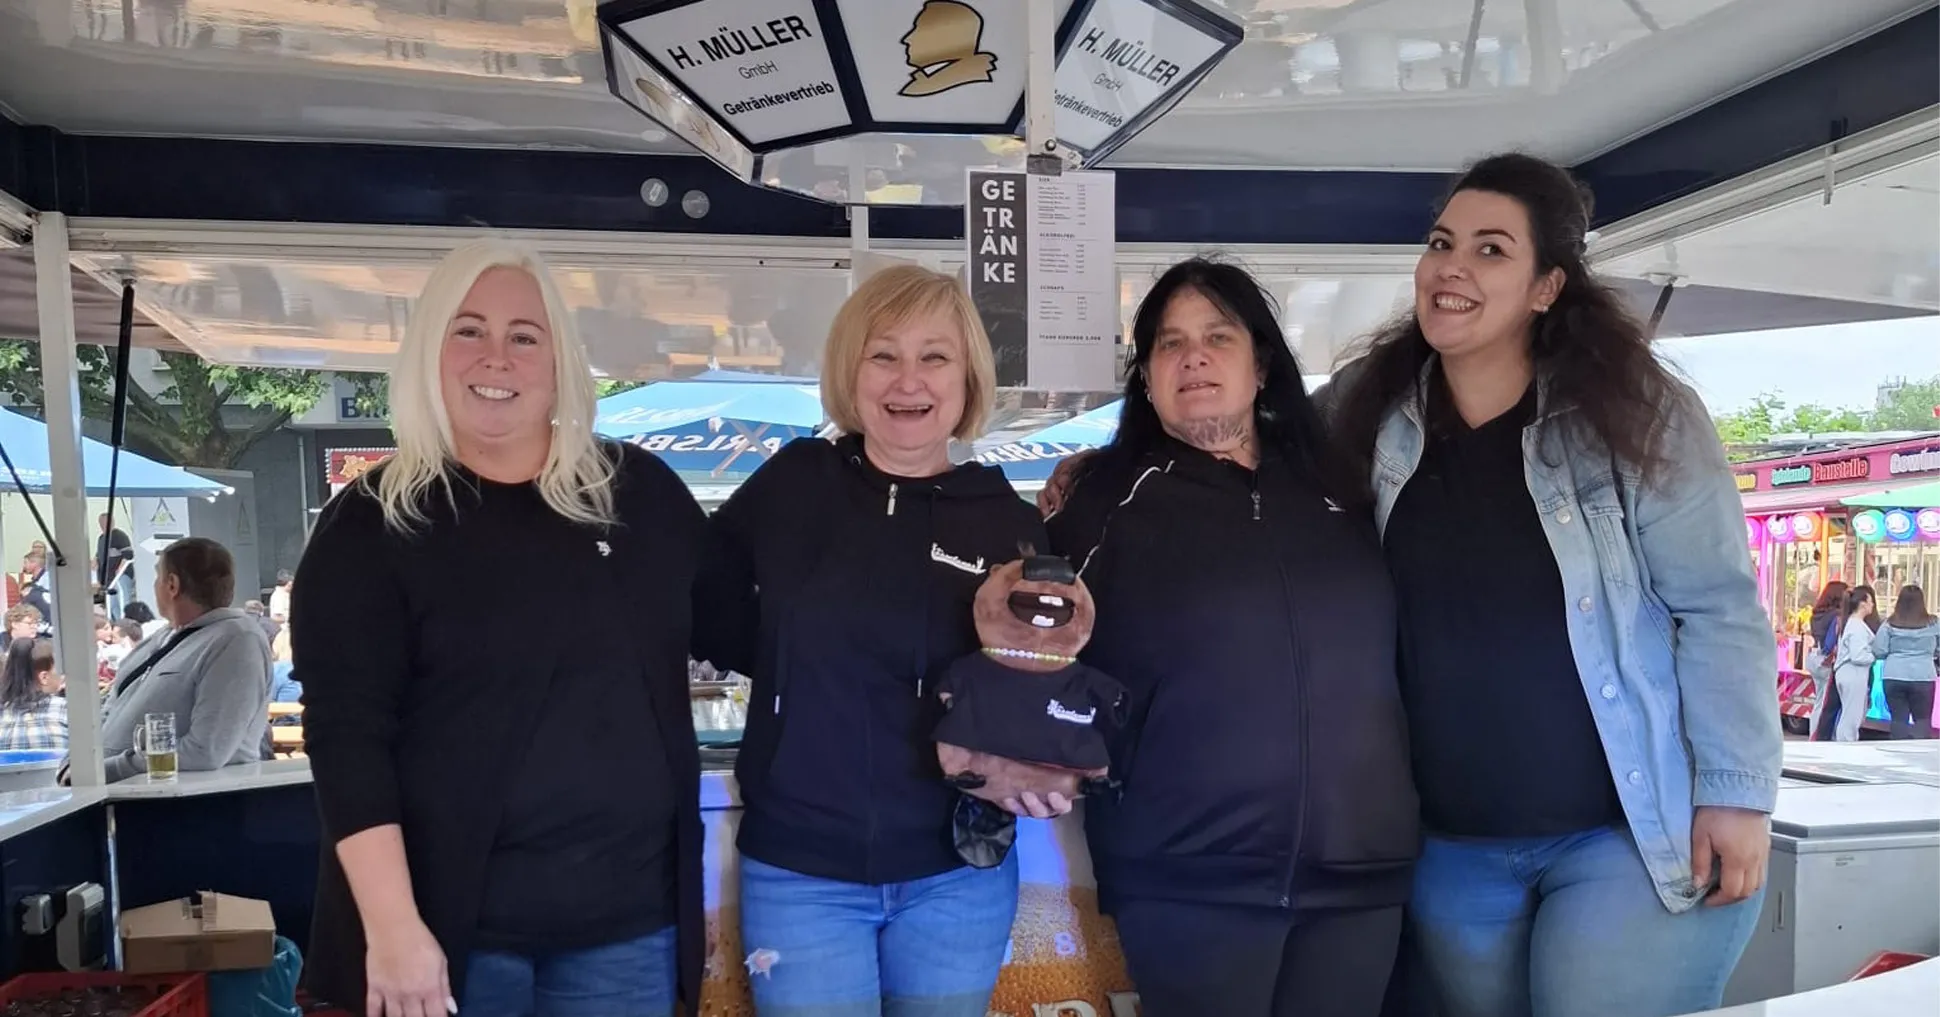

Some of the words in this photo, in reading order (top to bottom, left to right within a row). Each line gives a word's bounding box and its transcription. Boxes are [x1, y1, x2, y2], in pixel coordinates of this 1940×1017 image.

[666, 45, 703, 70] H.
[698, 15, 812, 62] MÜLLER
[738, 60, 780, 80] GmbH
[1077, 27, 1105, 54] H.
[1100, 38, 1180, 87] MÜLLER
[723, 80, 835, 115] Getränkevertrieb
[1053, 89, 1123, 128] etränkevertrieb
[981, 179, 1016, 201] GE
[982, 207, 1015, 228] TR
[979, 228, 1018, 256] ÄN
[983, 262, 1016, 284] KE
[1814, 458, 1868, 482] Baustelle
